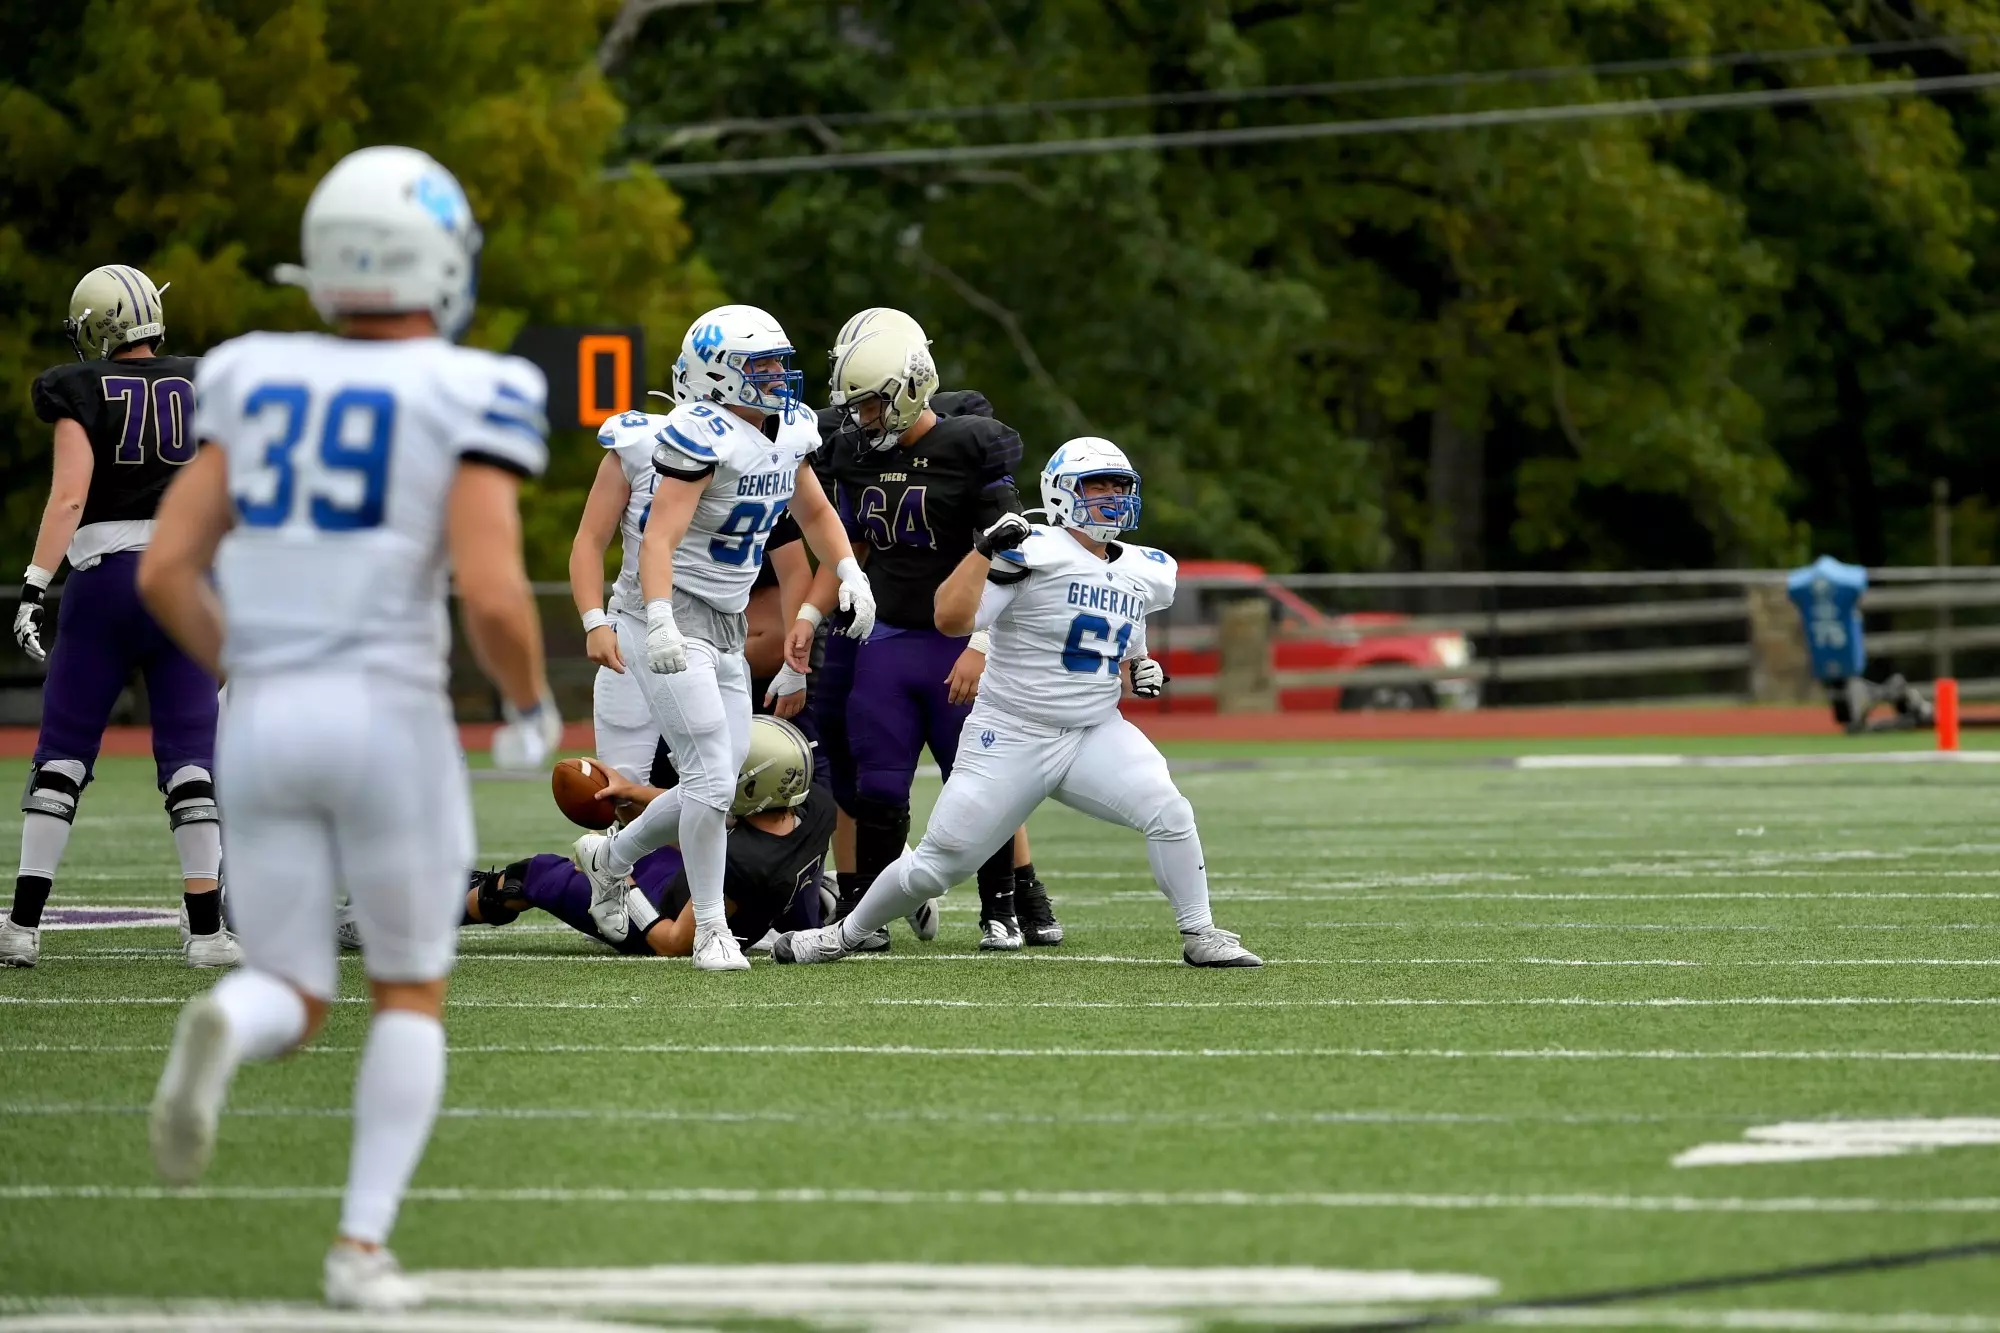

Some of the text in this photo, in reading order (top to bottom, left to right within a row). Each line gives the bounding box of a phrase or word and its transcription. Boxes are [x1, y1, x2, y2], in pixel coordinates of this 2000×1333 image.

[132, 327, 157, 338] VICIS
[578, 335, 632, 427] 0
[101, 376, 198, 465] 70
[689, 405, 735, 437] 95
[236, 384, 396, 531] 39
[736, 469, 798, 496] GENERAL
[880, 473, 908, 482] TIGERS
[857, 485, 937, 551] 64
[1067, 581, 1144, 622] GENERALS
[1061, 611, 1133, 675] 61
